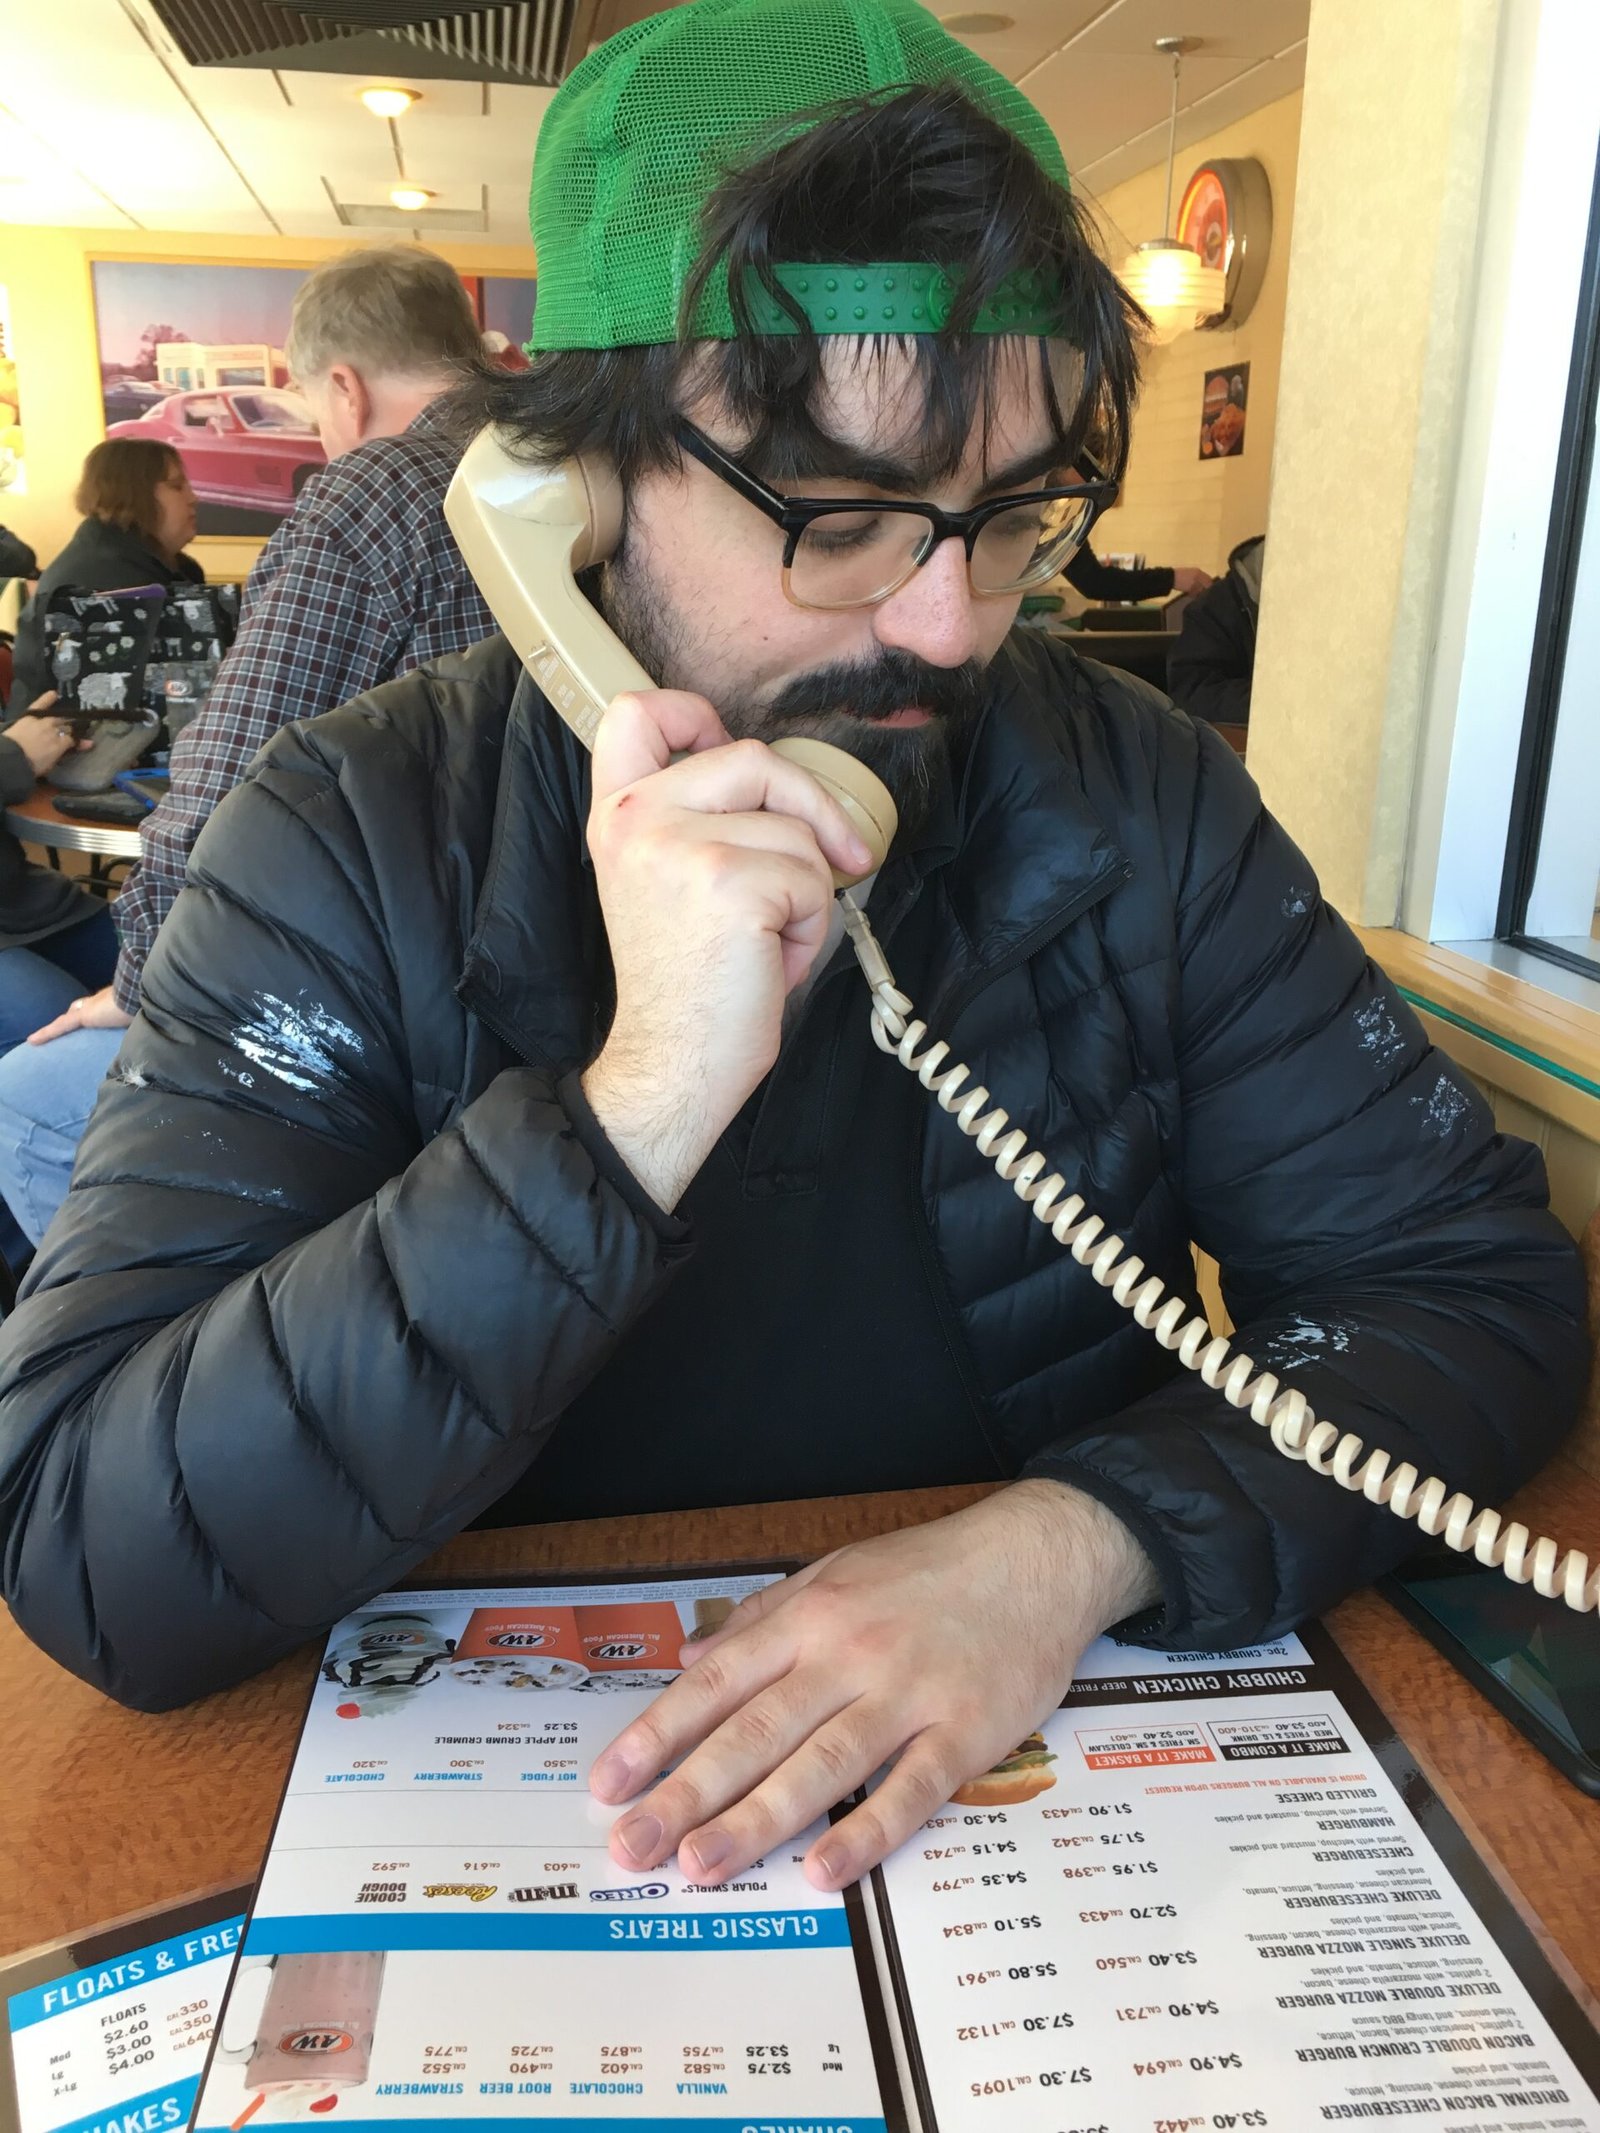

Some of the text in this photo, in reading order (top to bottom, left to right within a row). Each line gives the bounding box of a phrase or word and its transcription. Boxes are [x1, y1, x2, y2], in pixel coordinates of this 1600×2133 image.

[606, 1633, 645, 1641] AMERICAN
[1166, 1646, 1288, 1663] 2pc. CHUBBY CHICKEN
[1069, 1670, 1306, 1695] CHUBBY CHICKEN DEEP FRIED
[544, 1722, 578, 1732] $3.25
[1275, 1721, 1305, 1731] $3.40
[434, 1736, 578, 1744] HOT APPLE CRUMB CRUMBLE
[1143, 1731, 1173, 1740] $2.40
[1230, 1734, 1258, 1743] DRINK
[1276, 1732, 1282, 1740] &
[1284, 1731, 1310, 1739] FRIES
[1088, 1743, 1131, 1752] COLESLAW
[1230, 1740, 1341, 1757] MAKE IT A COMBO
[1094, 1749, 1207, 1766] MAKE IT A BASKET
[324, 1773, 384, 1782] CHOCOLATE
[414, 1772, 482, 1781] STRAWBERRY
[520, 1772, 576, 1781] HOT FUDGE
[1251, 1780, 1267, 1788] ALL
[1283, 1776, 1328, 1785] AVAILABLE
[1144, 1785, 1183, 1794] REQUEST
[1184, 1783, 1208, 1792] UPON
[1210, 1781, 1250, 1791] BURGERS
[1275, 1788, 1377, 1803] GRILLED CHEESE
[1042, 1802, 1132, 1819] $1.90 CAL433
[964, 1812, 1007, 1826] $4.30
[1316, 1817, 1395, 1830] HAMBURGER
[1052, 1831, 1145, 1848] $1.75 CAL342
[923, 1840, 1016, 1860] $4.15 CAL743
[1312, 1846, 1414, 1861] CHEESEBURGER
[372, 1862, 580, 1871] CAL603 CAL616 CAL592
[1062, 1861, 1158, 1878] $1.95 CAL398
[362, 1882, 406, 1892] DOUGH
[732, 1882, 767, 1891] POLAR
[932, 1870, 1027, 1892] $4.35 CAL799
[355, 1892, 406, 1903] COOKIE
[590, 1883, 669, 1902] OREO
[1283, 1889, 1441, 1908] DELUXE CHEESEBURGER
[1078, 1904, 1177, 1922] $2.70 CAL433
[609, 1915, 818, 1939] CLASSIC TREATS
[943, 1915, 1042, 1938] $5.10 CAL834
[1257, 1933, 1470, 1958] DELUXE SINGLE MOZZA BURGER
[1095, 1951, 1197, 1971] $3.40 CAL560
[43, 1960, 145, 2013] FLOATS
[155, 1951, 175, 1970] &
[956, 1962, 1057, 1986] $5.80 CAL961
[1276, 1982, 1502, 2008] DELUXE DOUBLE MOZZA BURGER
[101, 2003, 146, 2027] FLOATS
[1115, 2000, 1219, 2021] $4.90 CAL731
[104, 1999, 208, 2044] $2.60 CAL330
[956, 2013, 1074, 2041] $7.30 CAL1132
[106, 2014, 212, 2059] $3.00 CAL350
[425, 2044, 840, 2057] Lg $3.25 CAL755 CAL875 CAL725 CAL775
[1295, 2033, 1535, 2062] BACON DOUBLE CRUNCH BURGER
[50, 2051, 71, 2065] Med
[109, 2051, 154, 2075] $4.00
[1133, 2053, 1242, 2076] $4.90 CAL694
[52, 2071, 64, 2080] Lg
[422, 2062, 843, 2074] Med $2.75 CAL582 CAL602 CAL490 CAL552
[376, 2082, 727, 2095] VANILLA CHOCOLATE ROOT BEER STRAWBERRY
[971, 2067, 1092, 2096] $7.30 CAL1095
[1320, 2089, 1569, 2119] ORIGINAL BACON CHEESEBURGER
[1153, 2108, 1268, 2133] $3.40 CAL442
